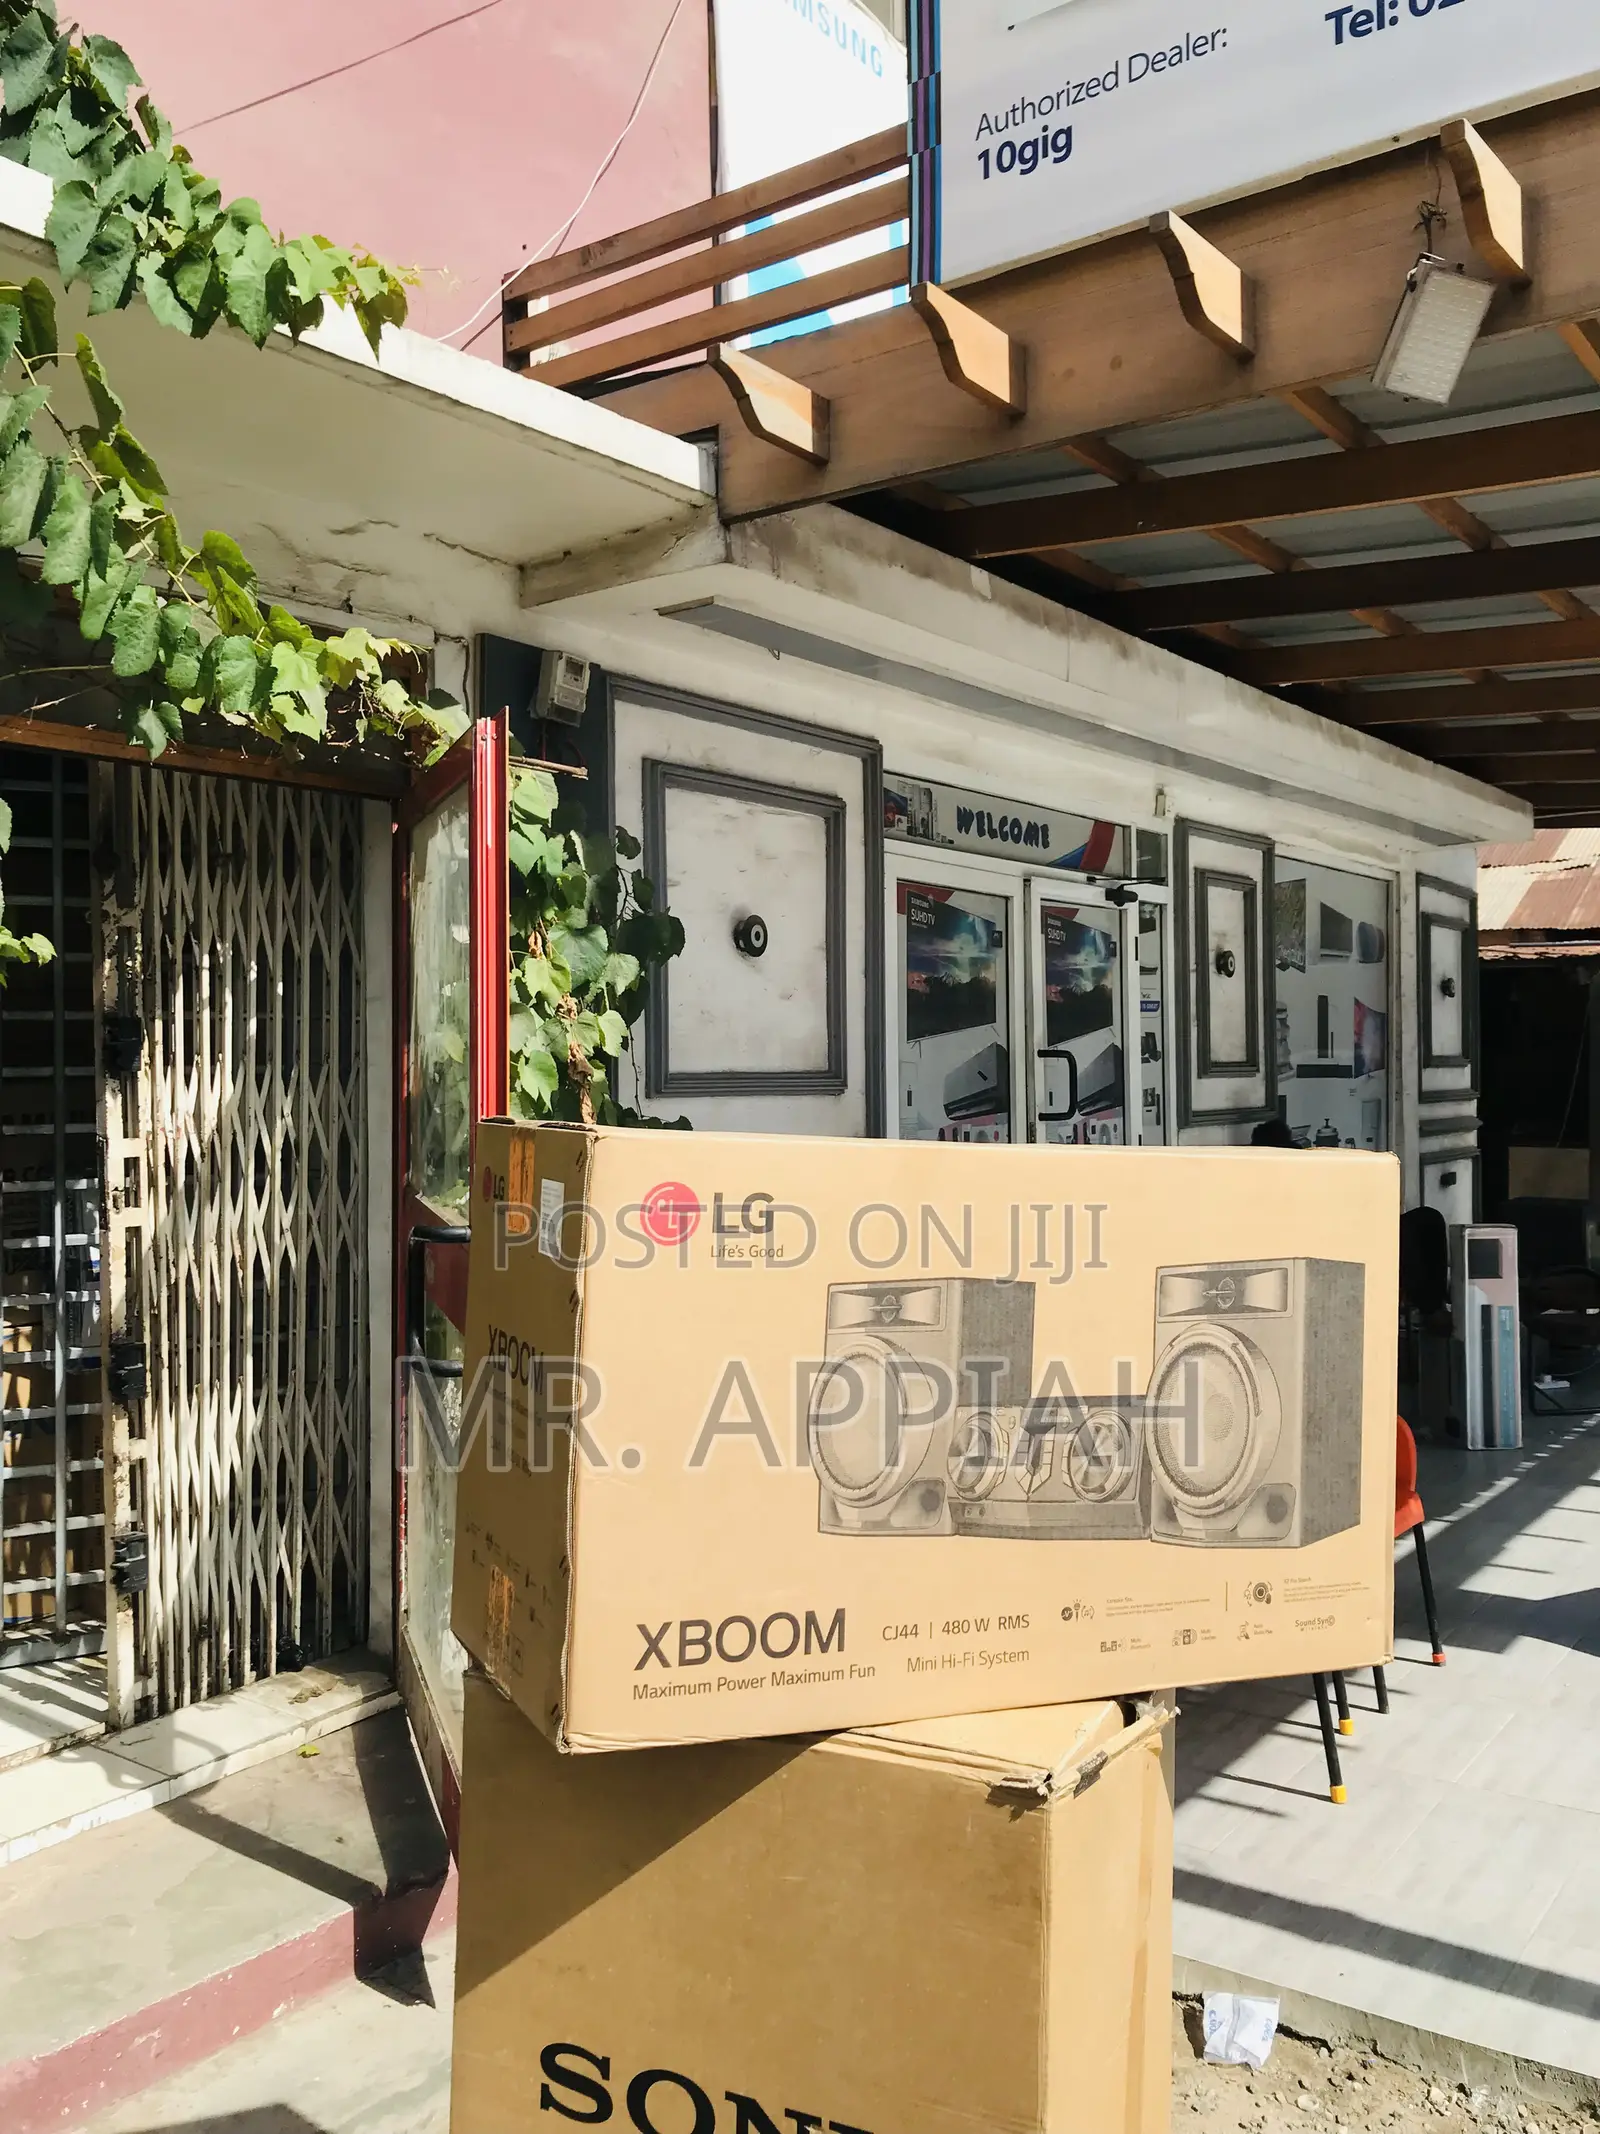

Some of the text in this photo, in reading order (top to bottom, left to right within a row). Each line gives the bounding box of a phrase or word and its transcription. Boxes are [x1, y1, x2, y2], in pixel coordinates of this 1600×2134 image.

[789, 0, 882, 77] MSUNG
[1324, 0, 1399, 46] Tel:
[975, 28, 1228, 141] Authorized Dealer:
[977, 124, 1073, 180] 10gig
[956, 805, 1050, 850] WELCOME
[712, 1192, 775, 1234] LG
[710, 1244, 785, 1258] Life's Good
[487, 1324, 544, 1396] XBOOM
[633, 1607, 1030, 1671] XBOOM CJ44 480 W RMS
[906, 1647, 1030, 1674] Mini Hi-Fi System
[633, 1663, 876, 1700] Maximum Power Maximum Fun
[540, 2042, 874, 2134] SON
